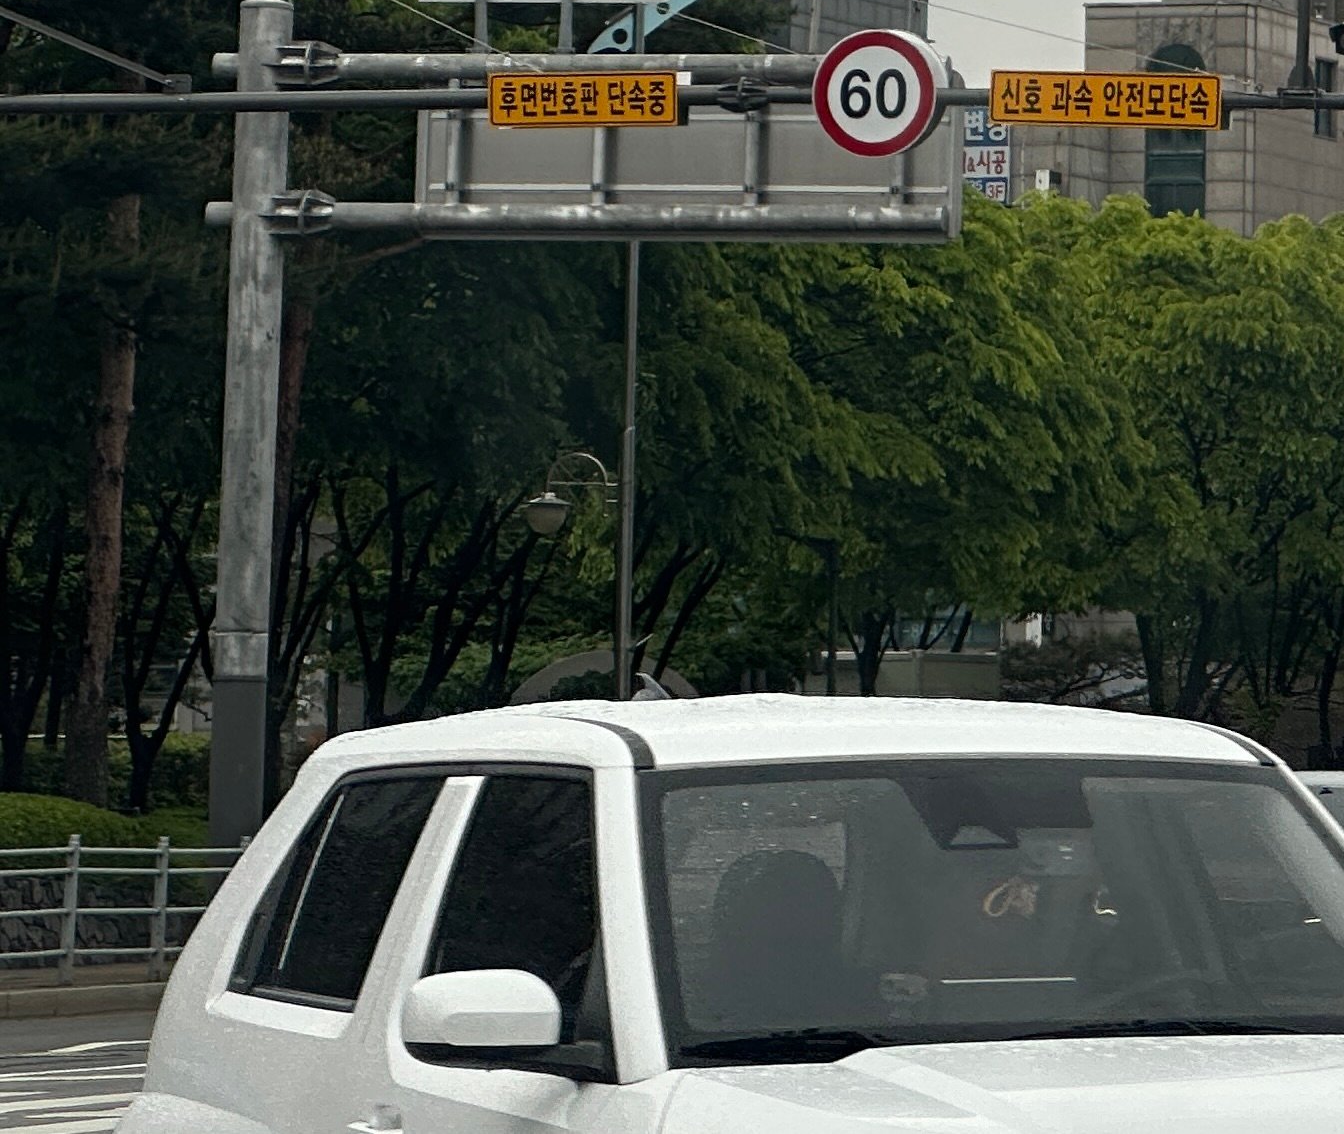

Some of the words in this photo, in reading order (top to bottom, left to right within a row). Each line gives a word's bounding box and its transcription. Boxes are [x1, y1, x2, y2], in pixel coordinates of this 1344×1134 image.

[499, 80, 599, 117] 후면번호판
[608, 80, 667, 116] 단속중
[840, 69, 907, 119] 60
[1001, 78, 1042, 115] 신호
[1051, 79, 1093, 117] 과속
[1103, 79, 1210, 120] 안전모단속
[988, 184, 1003, 198] 3F
